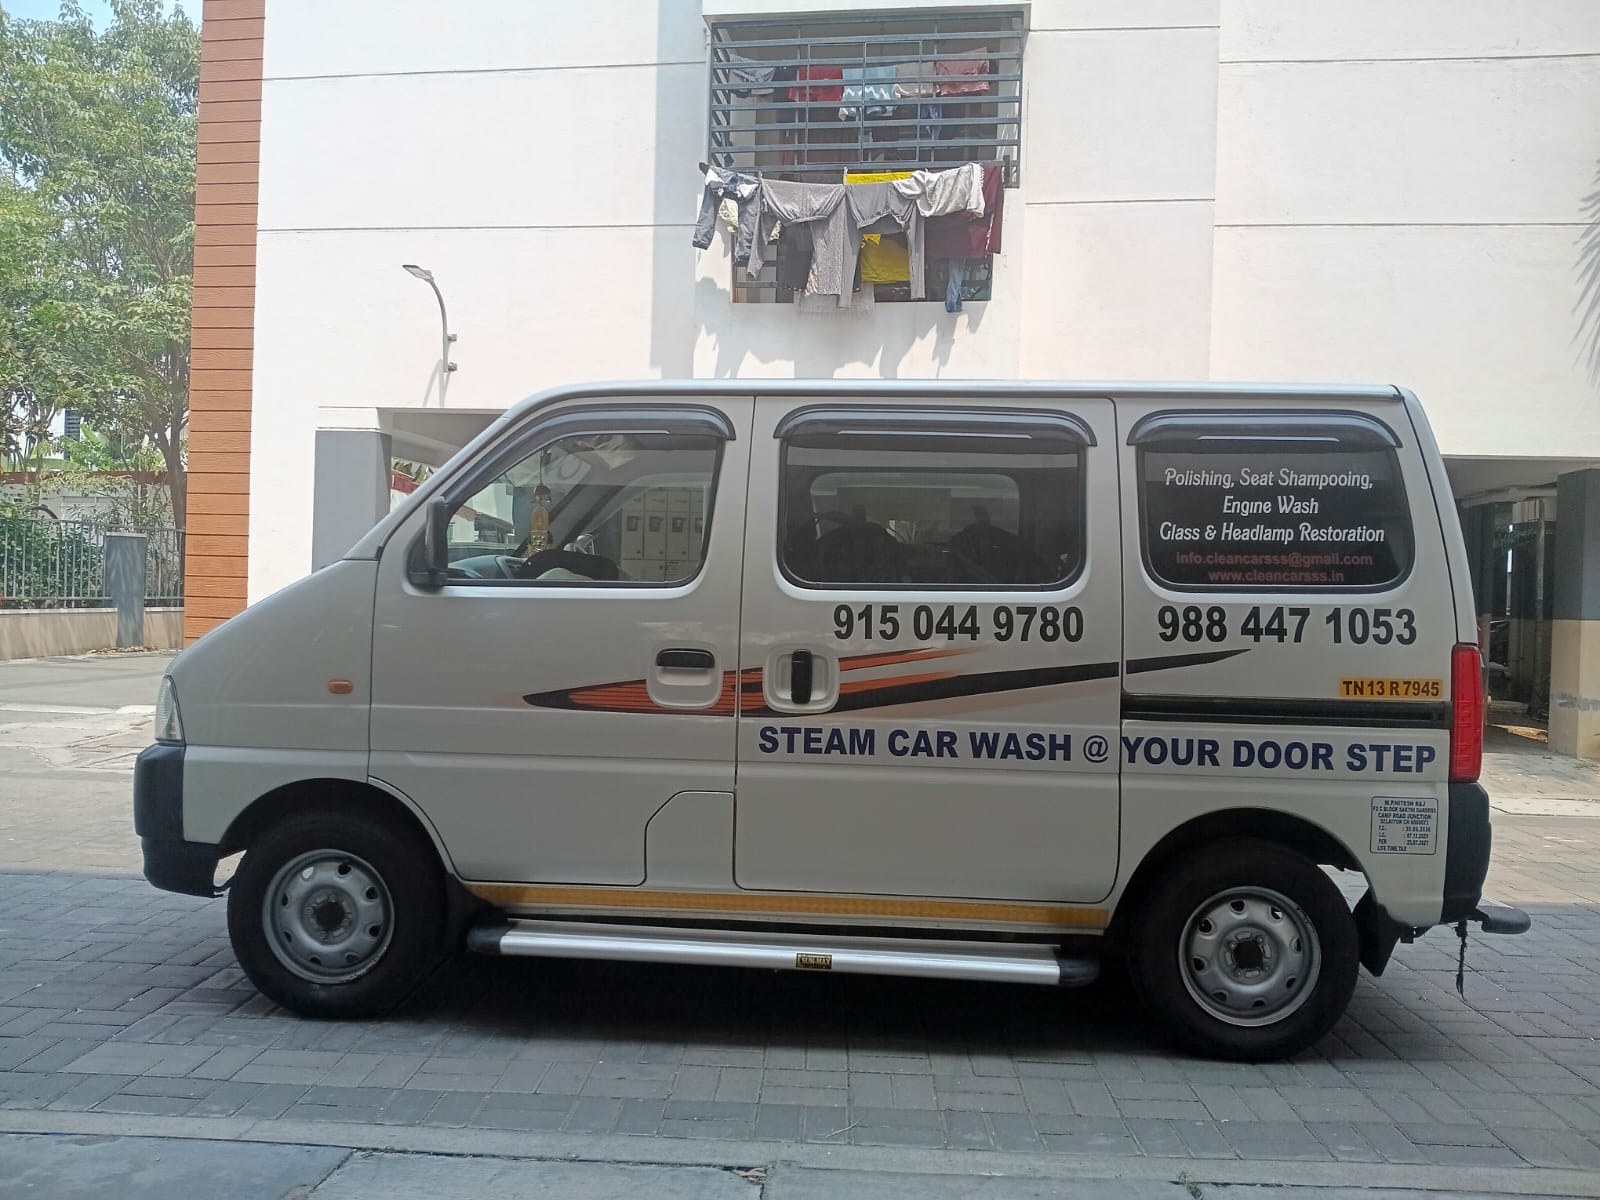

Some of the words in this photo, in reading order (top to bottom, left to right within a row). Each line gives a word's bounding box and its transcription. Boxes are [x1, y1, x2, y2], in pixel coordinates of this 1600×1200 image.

[1164, 467, 1235, 489] Polishing,
[1240, 467, 1274, 487] Seat
[1278, 467, 1373, 490] Shampooing,
[1223, 495, 1272, 516] Engine
[1278, 495, 1319, 514] Wash
[1159, 521, 1200, 541] Glass
[1205, 525, 1217, 541] &
[1221, 523, 1294, 544] Headlamp
[1299, 523, 1385, 542] Restoration
[1176, 552, 1373, 567] info.cleancarsss@gmail.com
[1208, 569, 1344, 583] www.cleancarsss.in
[833, 604, 900, 640] 915
[913, 605, 980, 641] 044
[993, 606, 1084, 643] 9780
[1157, 605, 1228, 643] 988
[1240, 606, 1311, 644] 447
[1325, 608, 1417, 645] 1053
[1342, 680, 1364, 696] TN
[1367, 680, 1385, 696] 13
[1389, 681, 1400, 696] R
[1403, 681, 1440, 697] 7945
[758, 726, 876, 756] STEAM
[888, 729, 958, 758] CAR
[969, 731, 1072, 762] WASH
[1083, 734, 1109, 764] @
[1121, 736, 1220, 767] YOUR
[1232, 739, 1335, 770] DOOR
[1346, 743, 1436, 773] STEP
